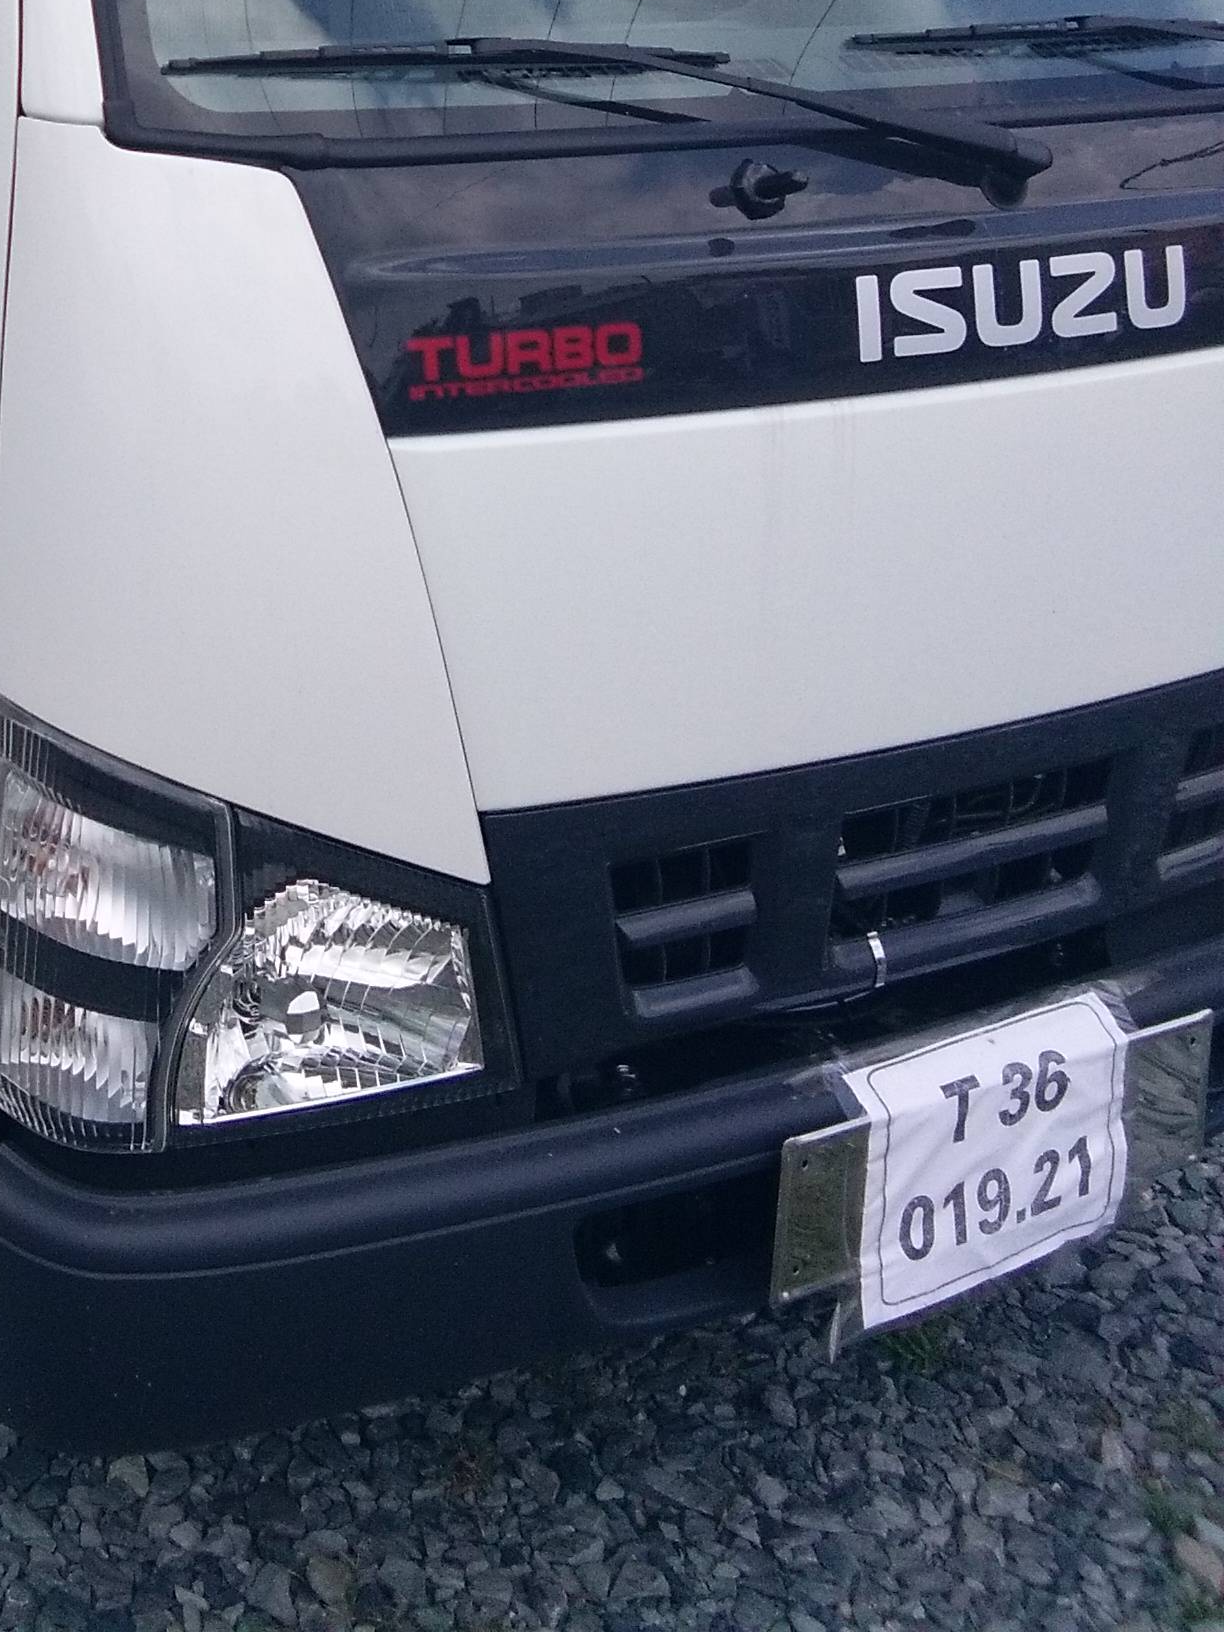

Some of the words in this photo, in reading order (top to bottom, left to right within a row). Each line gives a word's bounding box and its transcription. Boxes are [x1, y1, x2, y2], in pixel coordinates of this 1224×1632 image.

[406, 321, 643, 382] TURBO
[856, 244, 1186, 363] ISUZU
[940, 1074, 981, 1144] T
[998, 1049, 1071, 1128] 36
[898, 1135, 1094, 1261] 019.21
